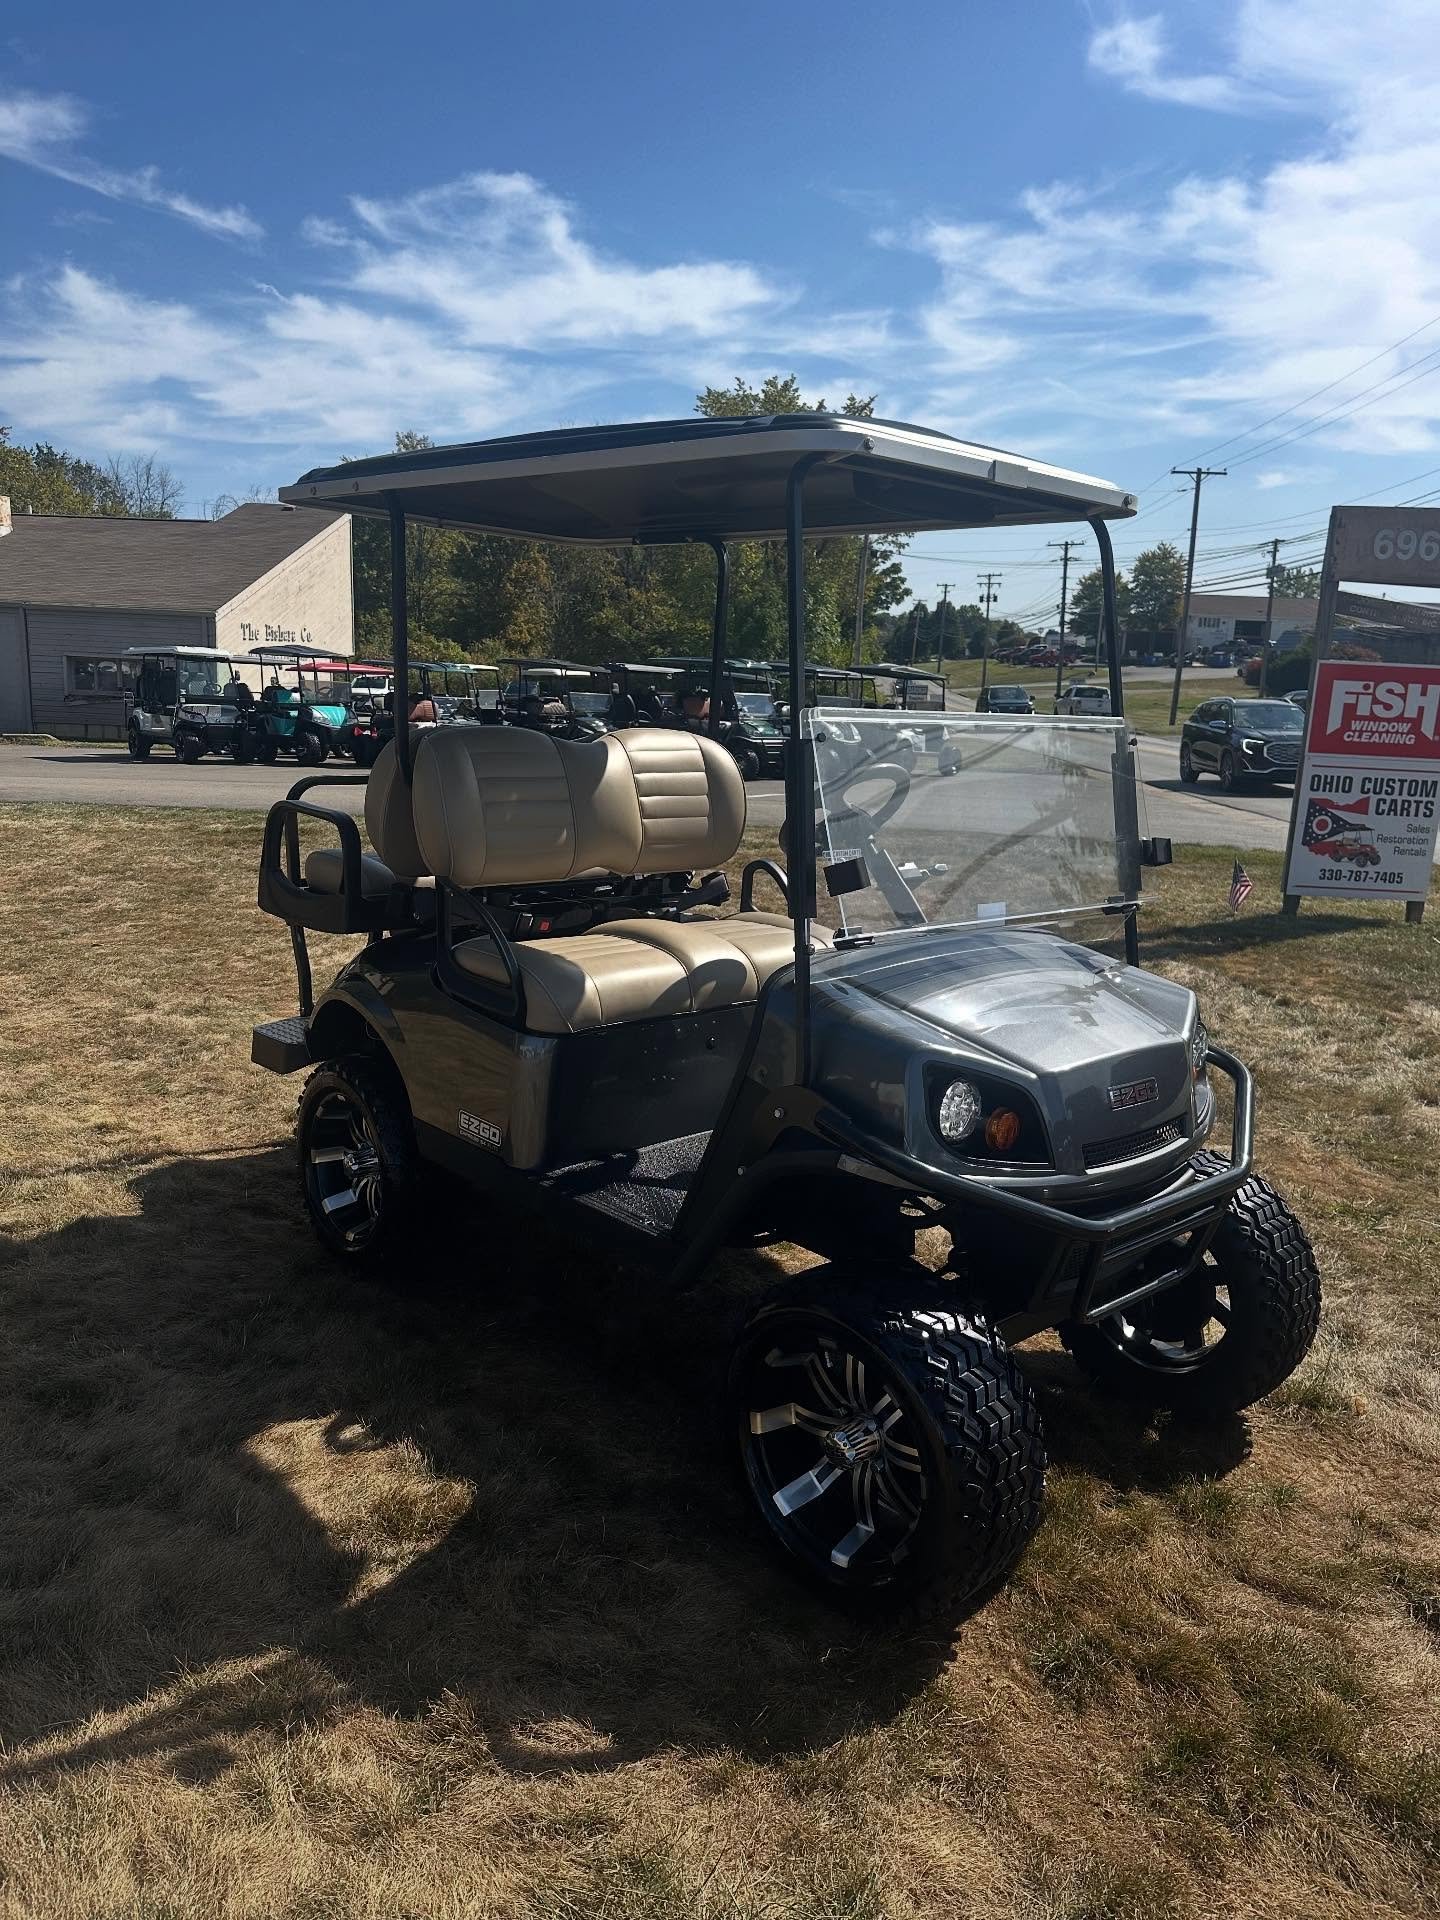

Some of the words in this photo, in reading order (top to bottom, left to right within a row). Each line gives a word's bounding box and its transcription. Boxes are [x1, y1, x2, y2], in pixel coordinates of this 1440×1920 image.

[1374, 528, 1440, 561] 696
[241, 622, 259, 641] The
[1351, 720, 1412, 733] WINDOW
[1343, 731, 1416, 744] CLEANING
[1309, 774, 1354, 794] OHIO
[1360, 776, 1438, 798] CUSTOM
[1374, 797, 1435, 818] CARTS
[1406, 823, 1431, 834] Sales
[1376, 834, 1430, 846] Restoration
[1393, 846, 1427, 857] Rentals
[1318, 868, 1403, 884] 330-787-7405
[460, 1112, 500, 1144] EZGO
